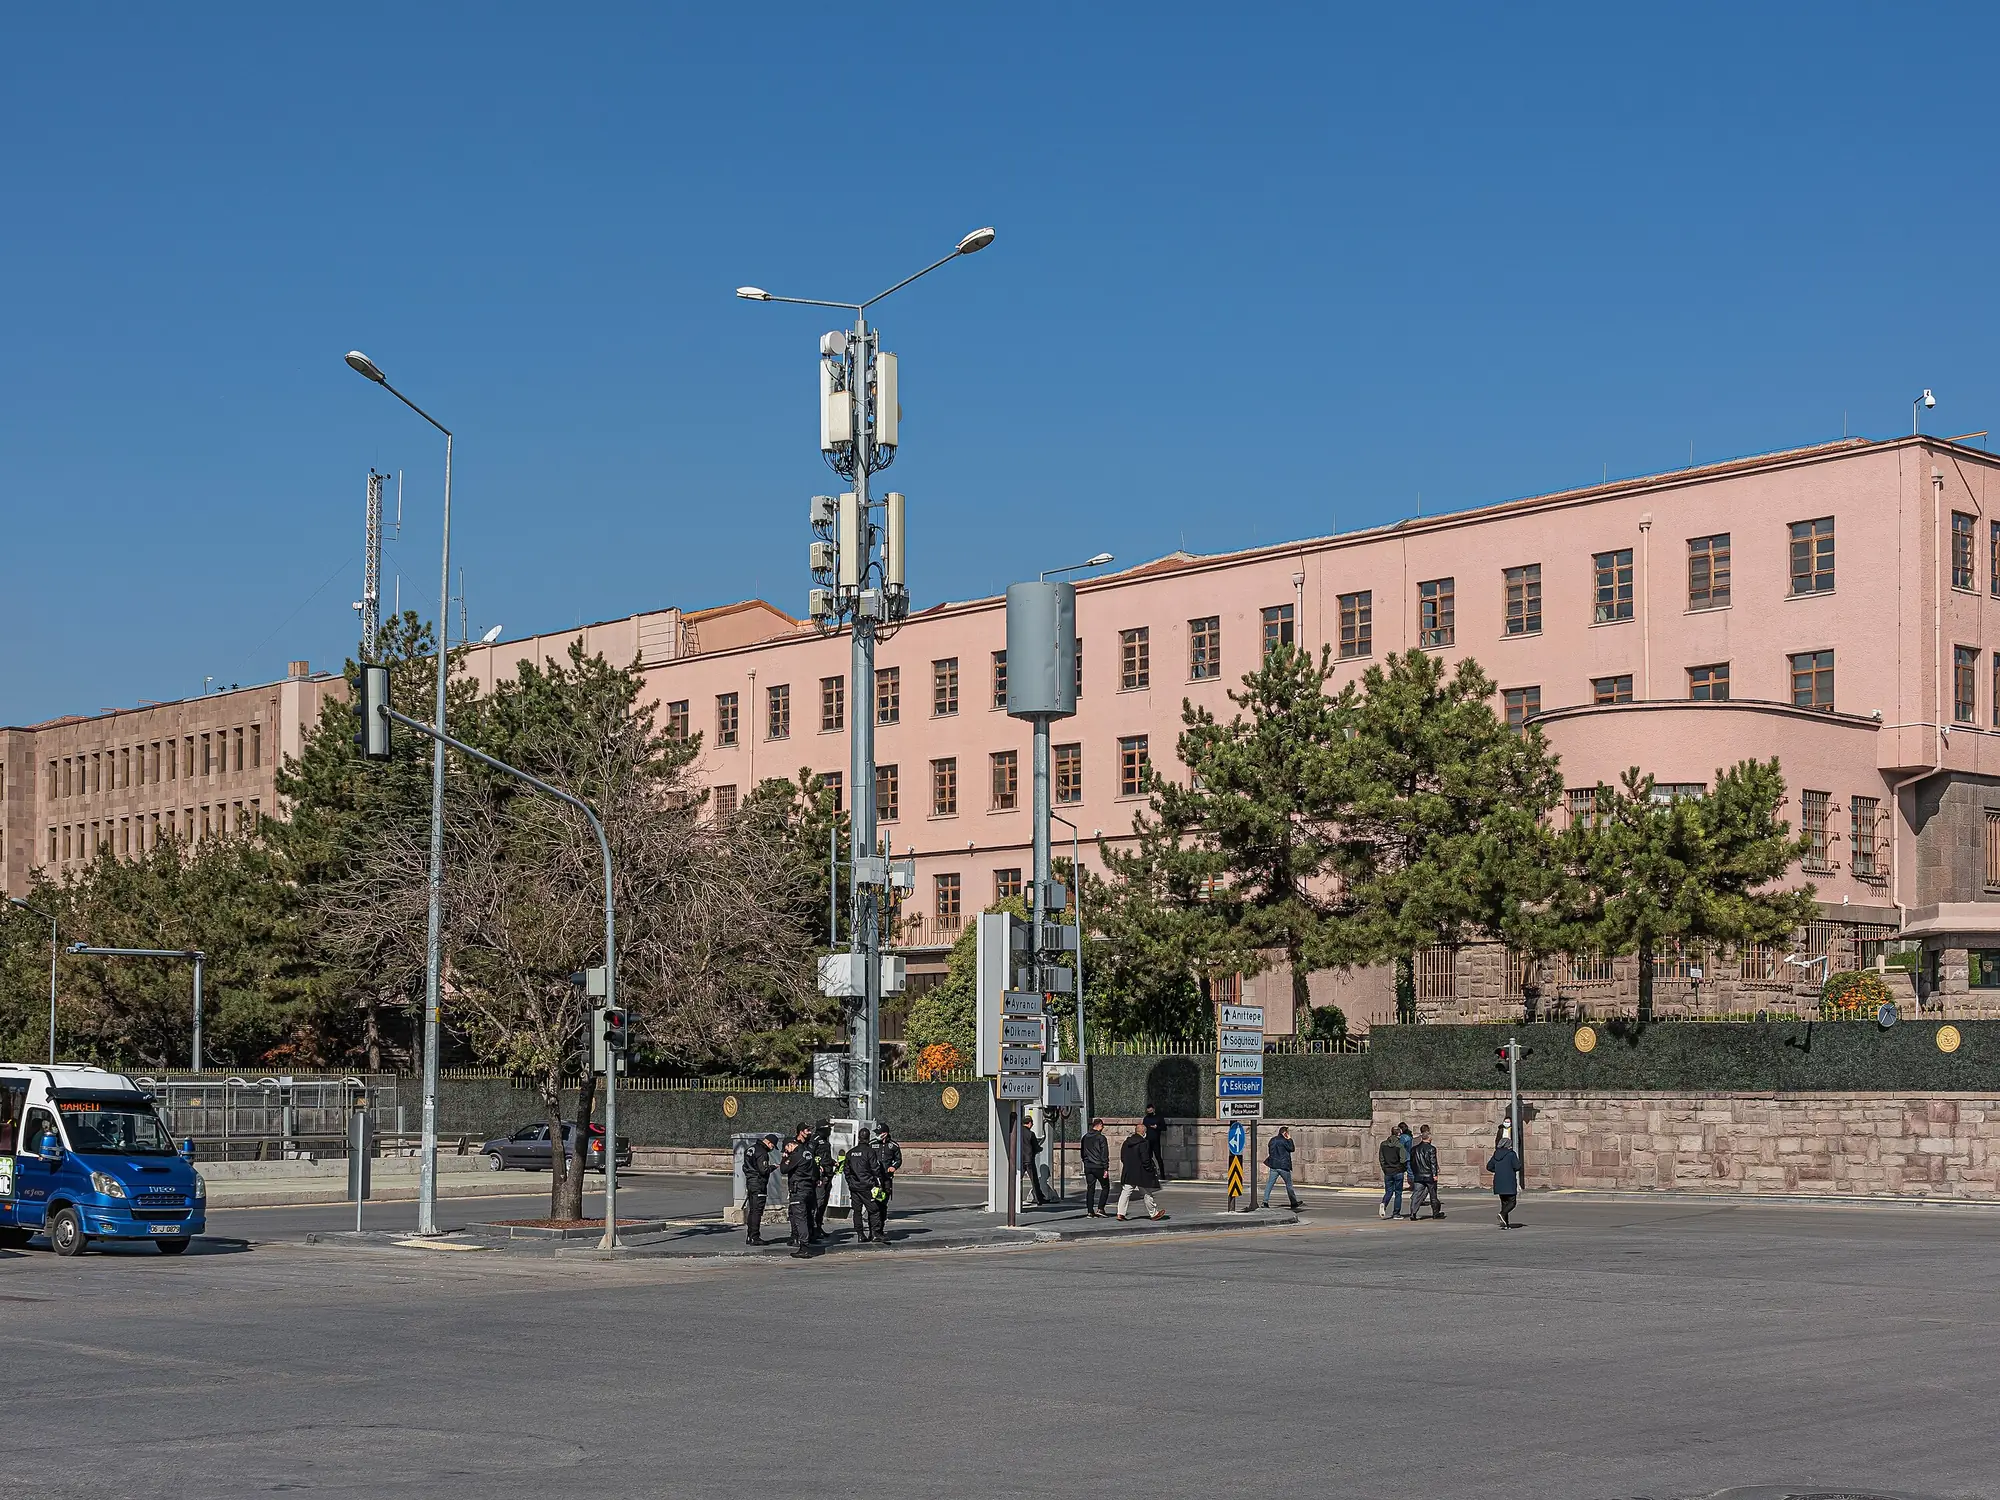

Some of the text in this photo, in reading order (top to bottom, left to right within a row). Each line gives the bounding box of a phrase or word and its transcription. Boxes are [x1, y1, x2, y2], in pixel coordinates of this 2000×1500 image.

[1011, 997, 1037, 1011] Ayrancı
[1231, 1010, 1261, 1022] Anıttepe
[1010, 1026, 1036, 1037] Dikmen
[1229, 1034, 1259, 1048] Söğütözü
[1009, 1054, 1031, 1067] Balgat
[1228, 1056, 1258, 1070] Ümitköy
[1008, 1080, 1034, 1093] Öveçler
[1229, 1080, 1260, 1092] Eskişehir
